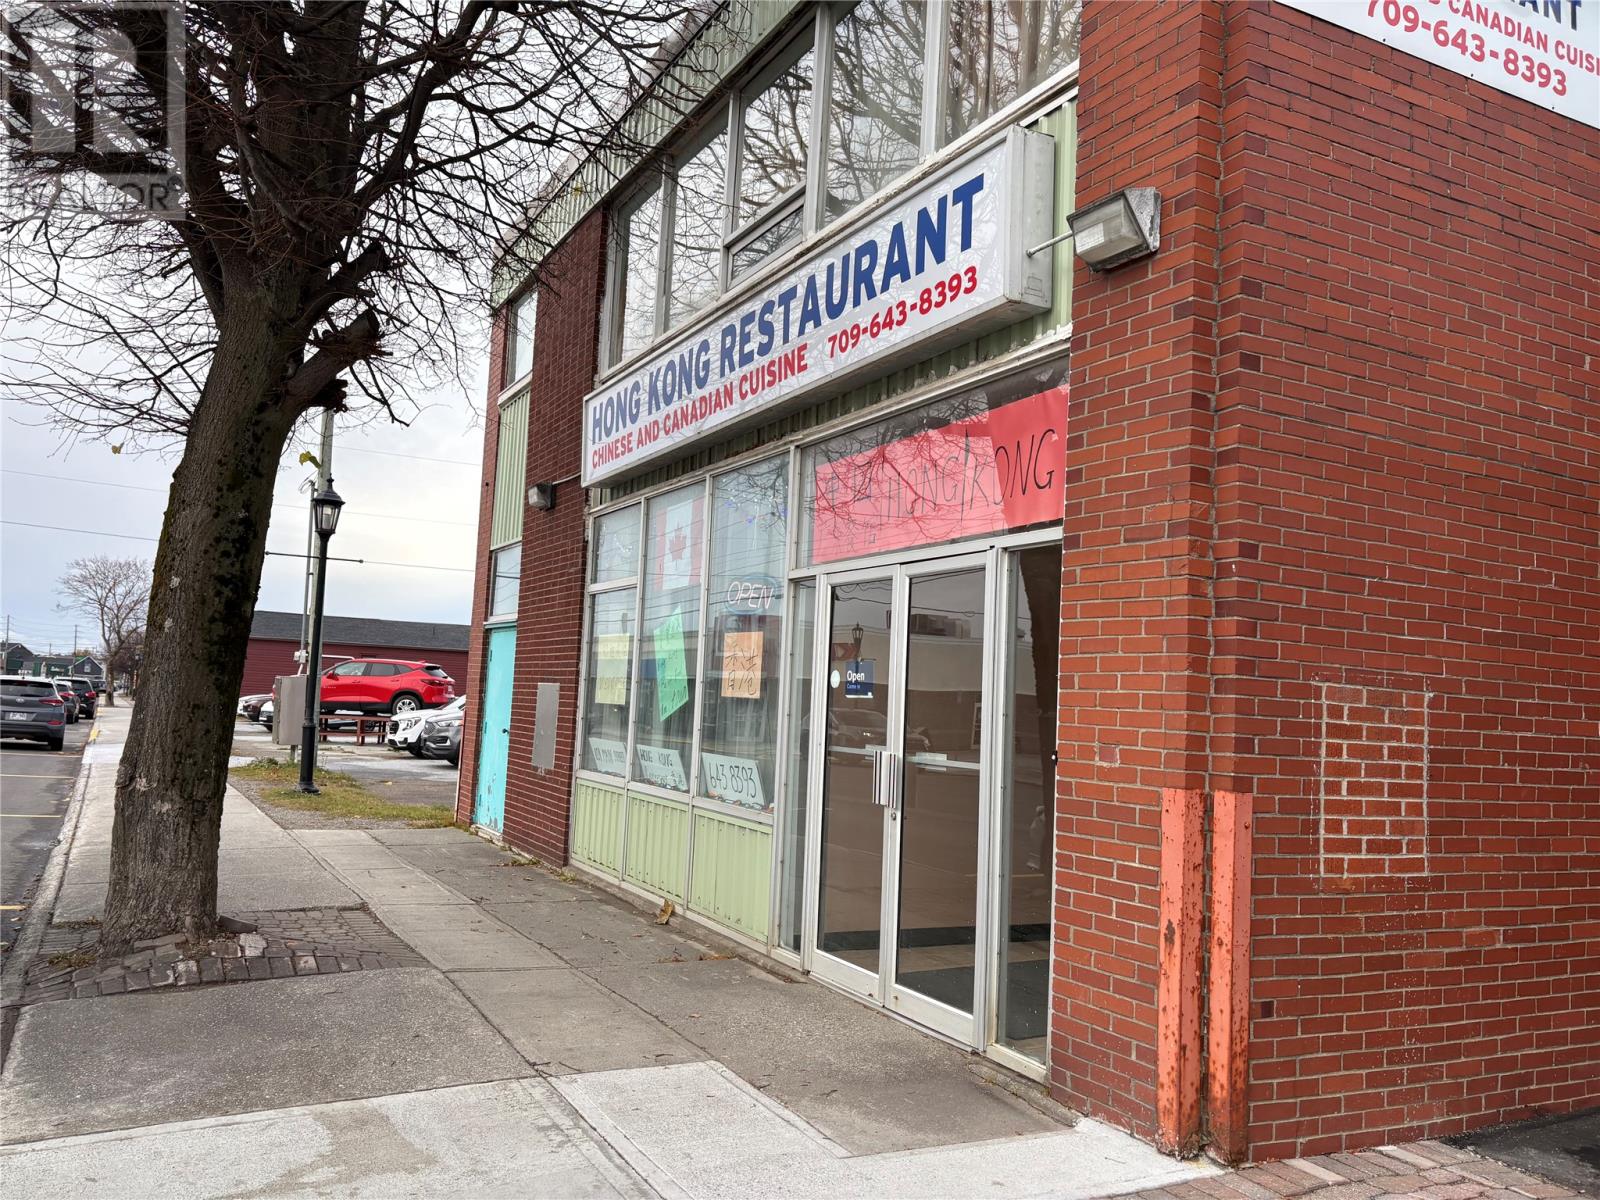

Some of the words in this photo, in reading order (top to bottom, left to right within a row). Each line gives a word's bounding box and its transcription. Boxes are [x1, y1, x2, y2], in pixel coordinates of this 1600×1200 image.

[1367, 0, 1567, 96] 709-643-8393
[1449, 0, 1548, 53] CANADIAN
[591, 380, 642, 446] HONG
[648, 339, 711, 416] KONG
[720, 172, 985, 379] RESTAURANT
[828, 265, 978, 359] 709-643-8393
[592, 432, 633, 469] CHINESE
[637, 418, 660, 448] AND
[663, 382, 733, 436] CANADIAN
[739, 342, 808, 401] CUISINE
[970, 428, 1056, 512] KONG
[727, 580, 775, 609] OPEN
[846, 670, 865, 683] Open
[708, 762, 728, 790] 643
[730, 764, 757, 798] 8393
